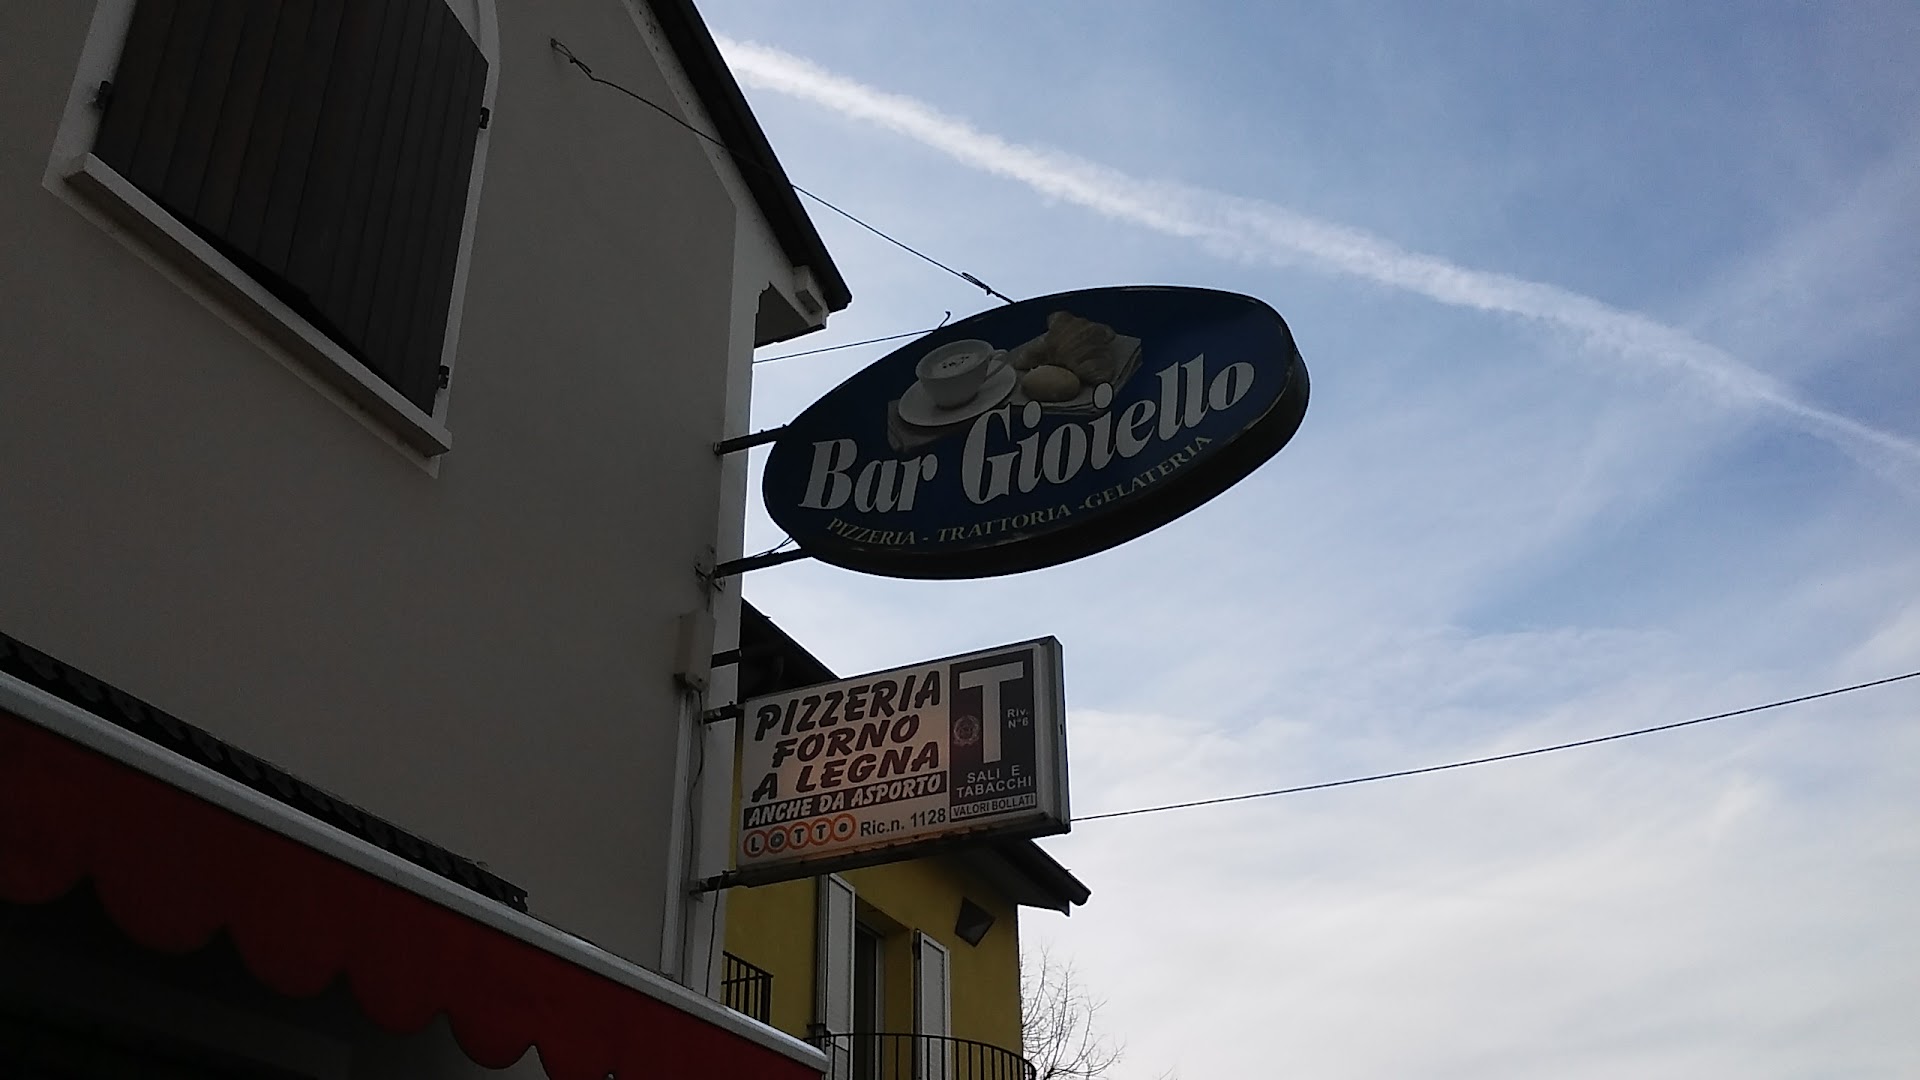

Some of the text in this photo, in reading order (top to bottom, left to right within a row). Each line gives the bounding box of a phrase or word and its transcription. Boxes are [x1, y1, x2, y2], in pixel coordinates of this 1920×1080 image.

[798, 353, 1255, 513] Bar Gioiello
[826, 517, 917, 547] PIZZERIA
[937, 503, 1072, 543] TRATTORIA
[754, 670, 941, 742] PIZZERIA
[958, 660, 1025, 764] T
[771, 713, 921, 769] FORNO
[751, 741, 940, 803] A LEGNA
[956, 775, 1032, 799] TABACCHI
[967, 764, 1021, 784] SALI E
[747, 773, 942, 827] ANCHE DA ASPORTO
[953, 793, 1035, 817] VALORI BOLLATI
[748, 820, 851, 854] LOTTO
[910, 807, 947, 828] 1128
